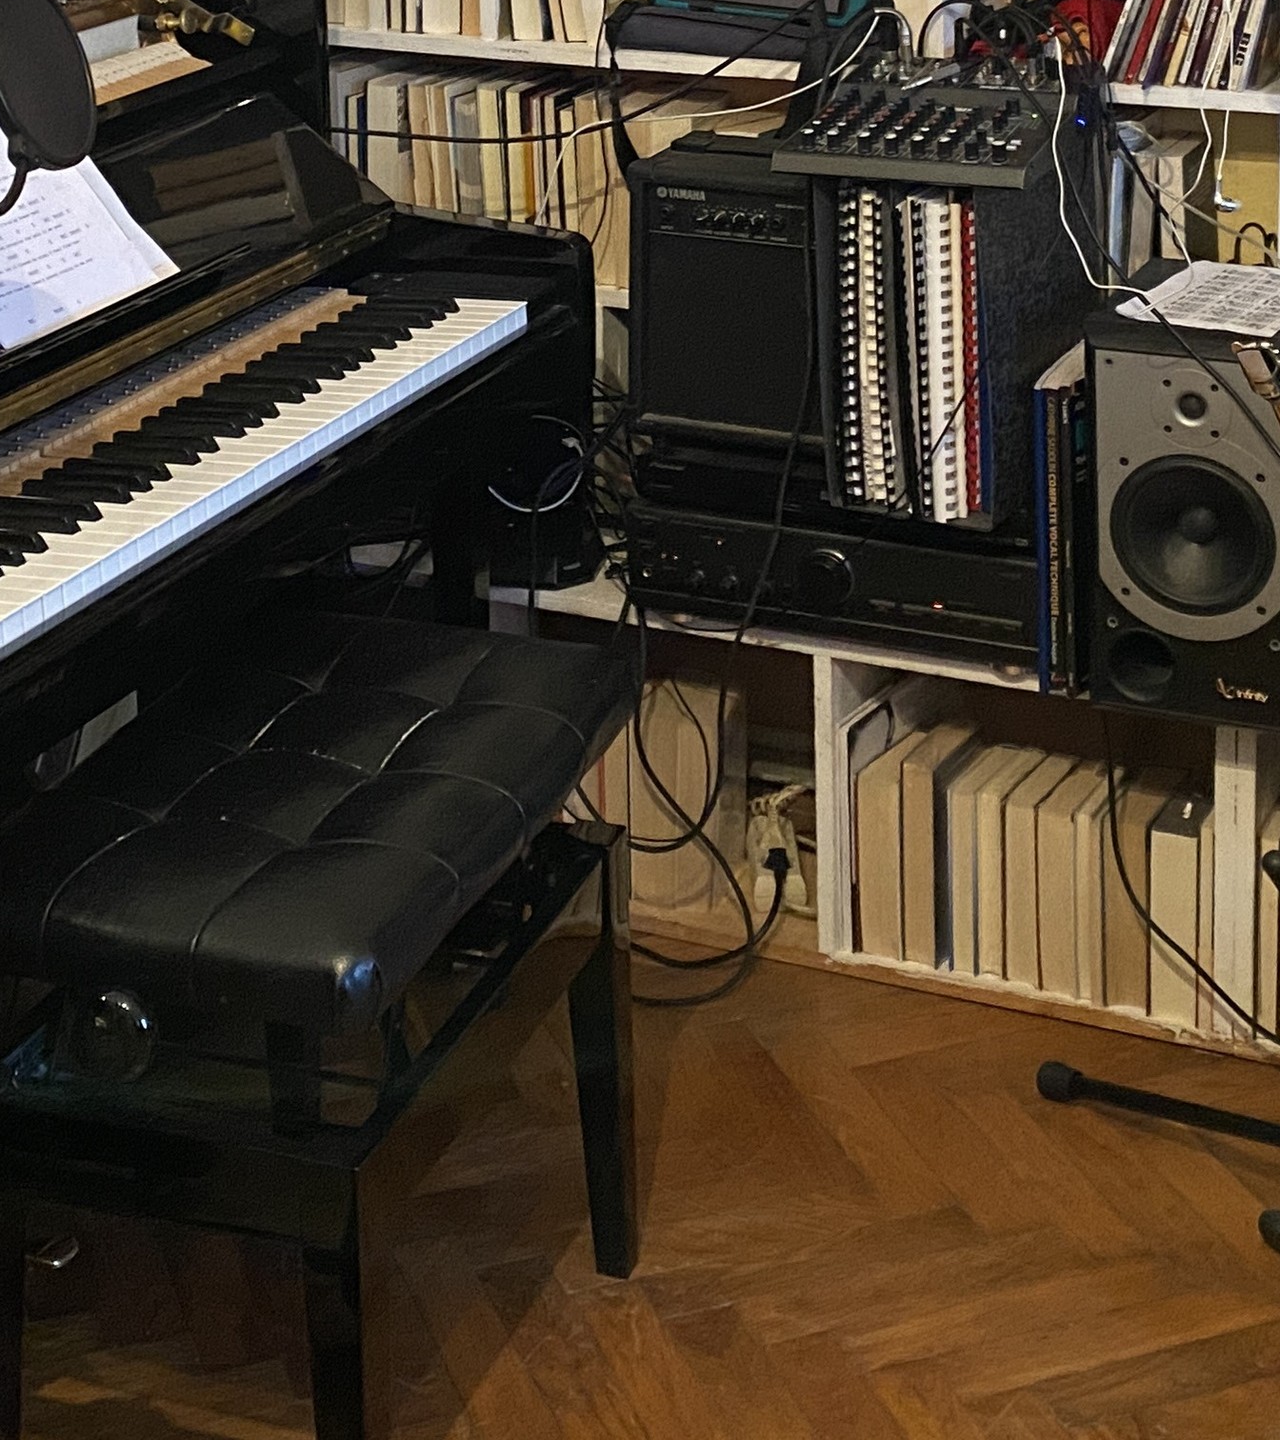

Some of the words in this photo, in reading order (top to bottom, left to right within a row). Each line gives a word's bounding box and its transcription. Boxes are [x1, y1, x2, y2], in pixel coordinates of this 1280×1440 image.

[668, 187, 706, 201] YAMAHA
[1048, 473, 1058, 525] COMPLETE
[1049, 525, 1059, 559] VOCAL
[1050, 560, 1060, 617] TECHNIQUE
